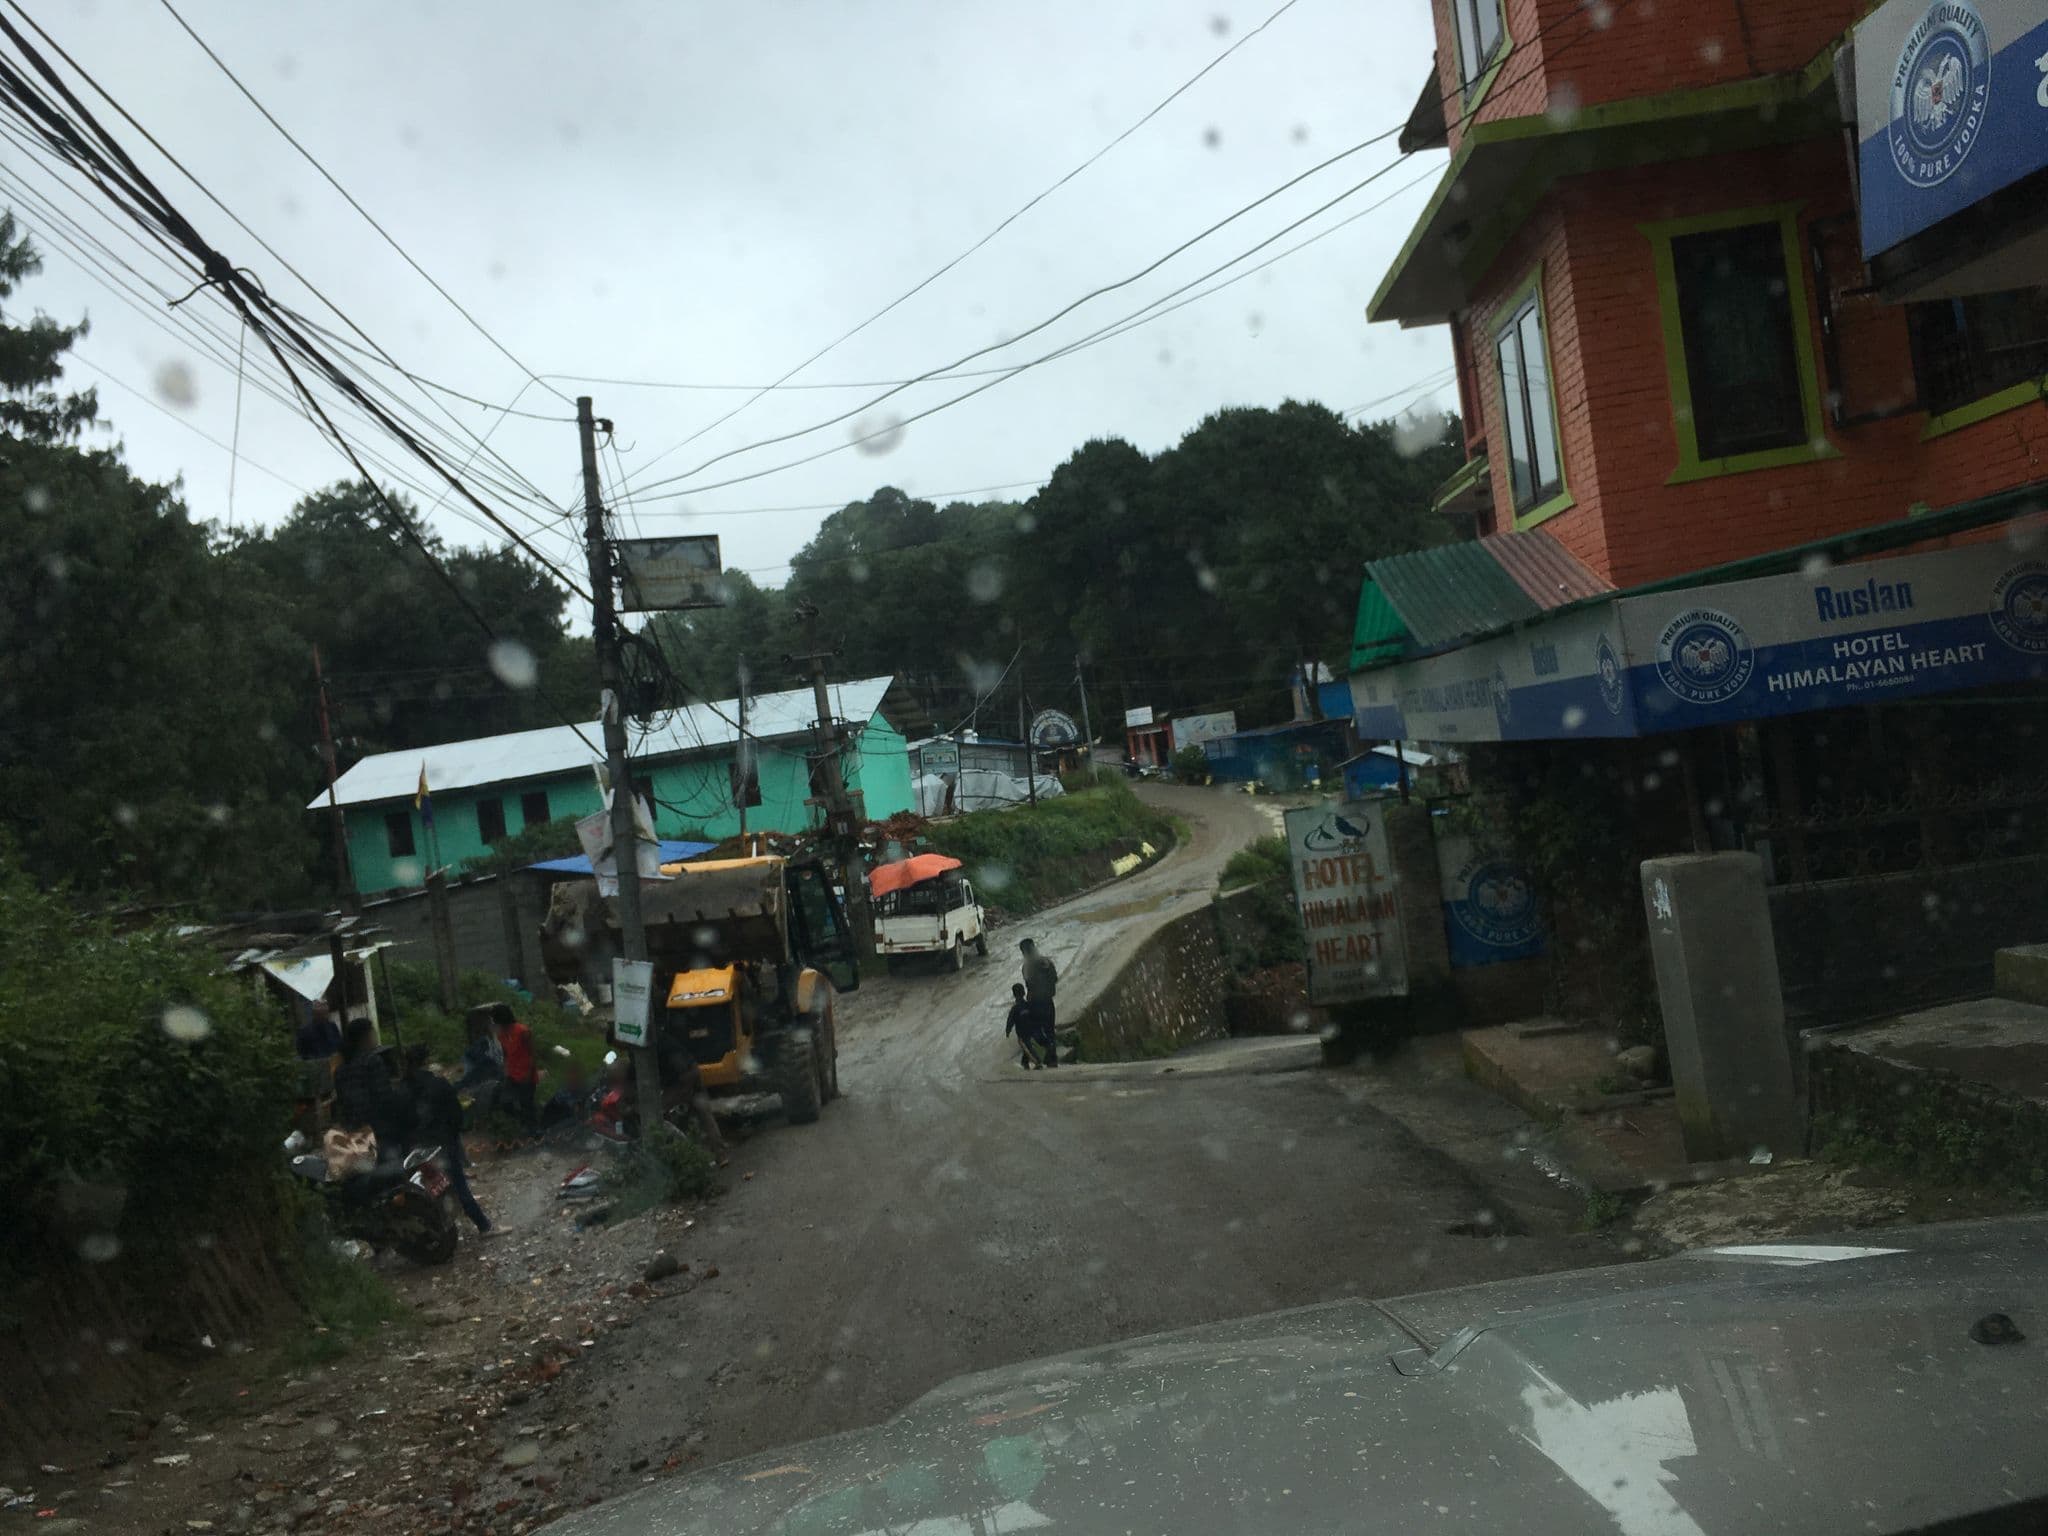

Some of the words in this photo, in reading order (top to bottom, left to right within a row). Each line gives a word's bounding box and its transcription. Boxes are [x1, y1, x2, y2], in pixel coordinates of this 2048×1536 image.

[1895, 15, 1939, 88] PREMIUM
[1939, 5, 1981, 39] QUALITY
[1895, 134, 1916, 174] 100%
[1919, 154, 1951, 178] PURE
[1954, 84, 1985, 154] VODKA
[1814, 577, 1915, 623] Ruslan
[1661, 611, 1700, 646] PREMIUM
[1702, 611, 1743, 636] QUALITY
[1833, 632, 1910, 659] HOTEL
[1691, 688, 1721, 700] PURE
[1723, 659, 1750, 692] VODKA
[1767, 655, 1905, 693] HIMALAYAN
[1911, 643, 1986, 670] HEART
[1303, 855, 1384, 891] HOTEL
[1316, 932, 1384, 966] HEART
